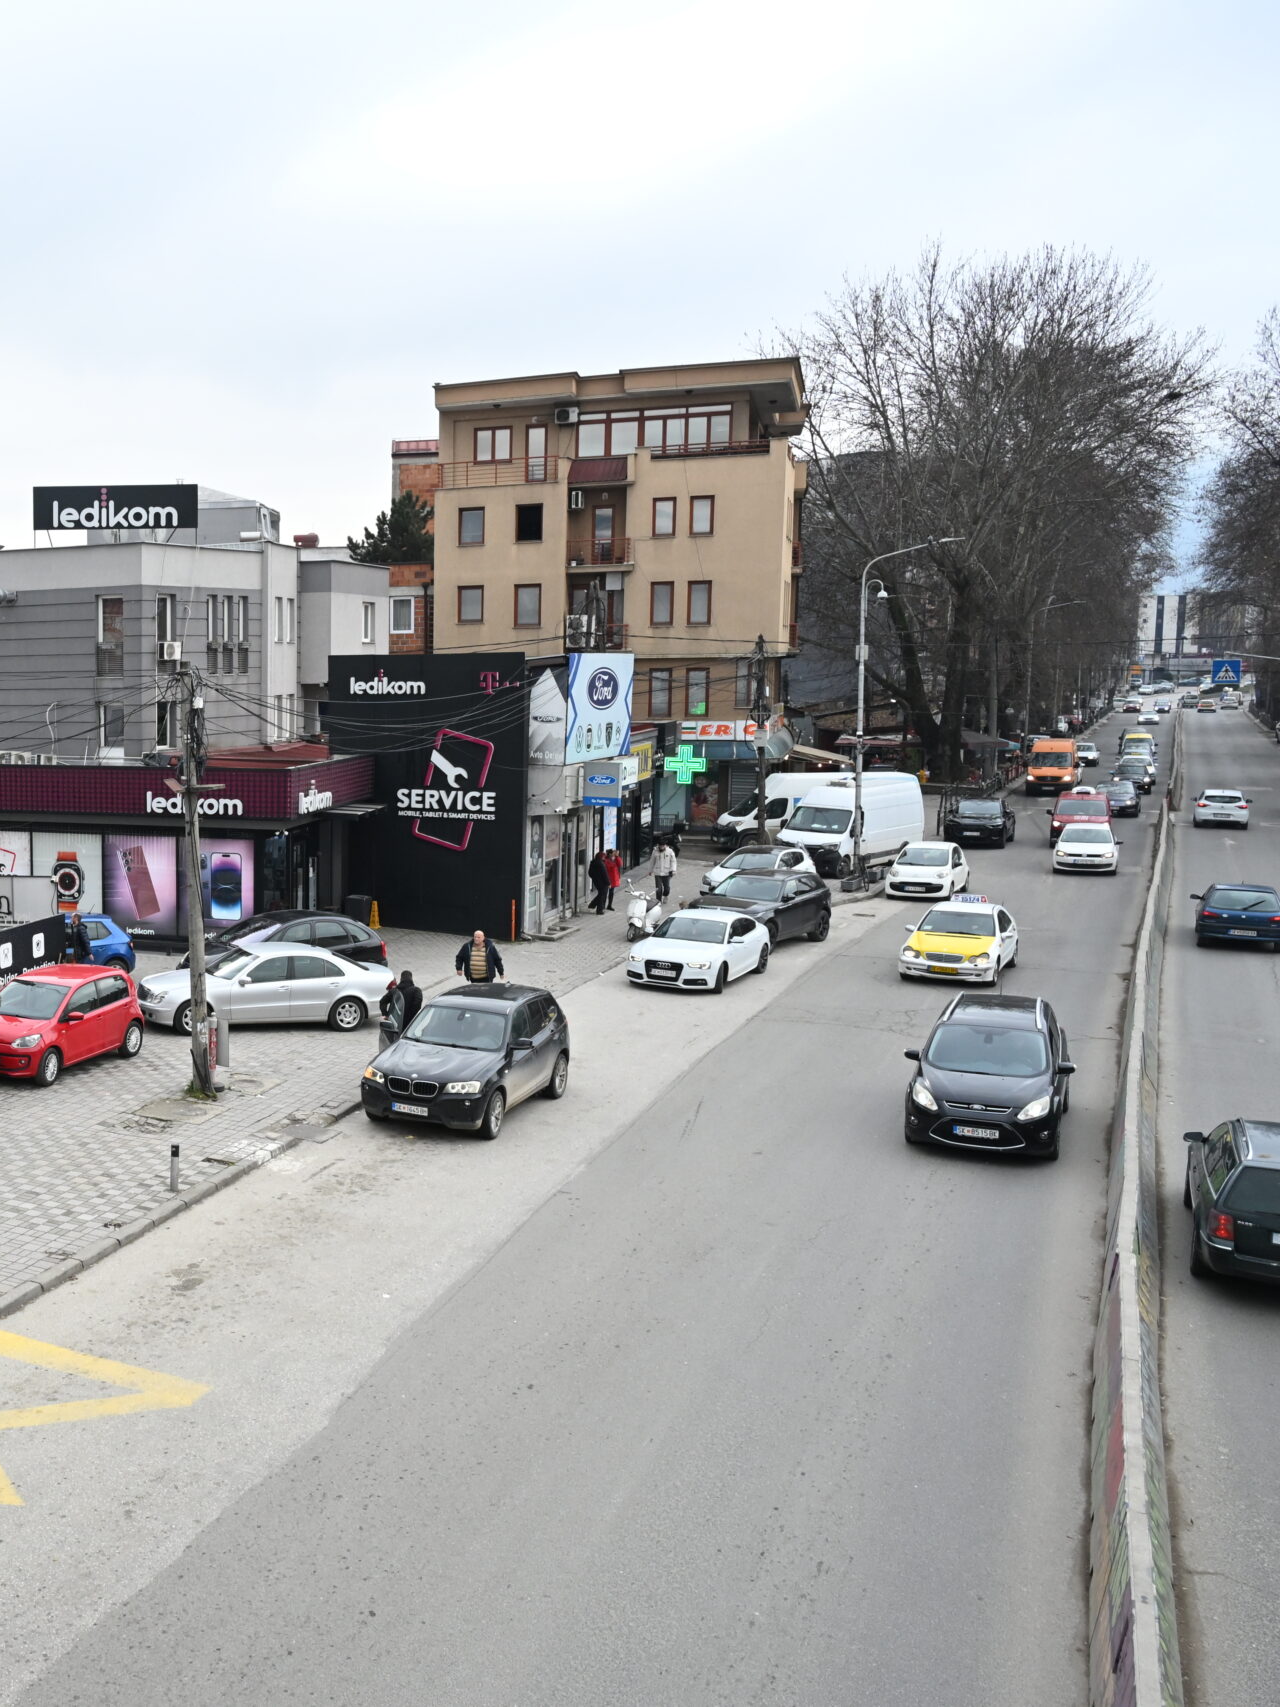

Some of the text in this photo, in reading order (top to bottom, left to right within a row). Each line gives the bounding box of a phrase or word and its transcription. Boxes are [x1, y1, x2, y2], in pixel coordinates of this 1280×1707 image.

[53, 488, 178, 528] ledikom
[350, 669, 426, 695] ledikom
[593, 674, 613, 701] Ford
[699, 724, 732, 737] ER
[298, 780, 333, 815] ledikom
[396, 788, 496, 812] SERVICE
[398, 810, 422, 818] MOBILE,
[126, 927, 155, 935] ledikom
